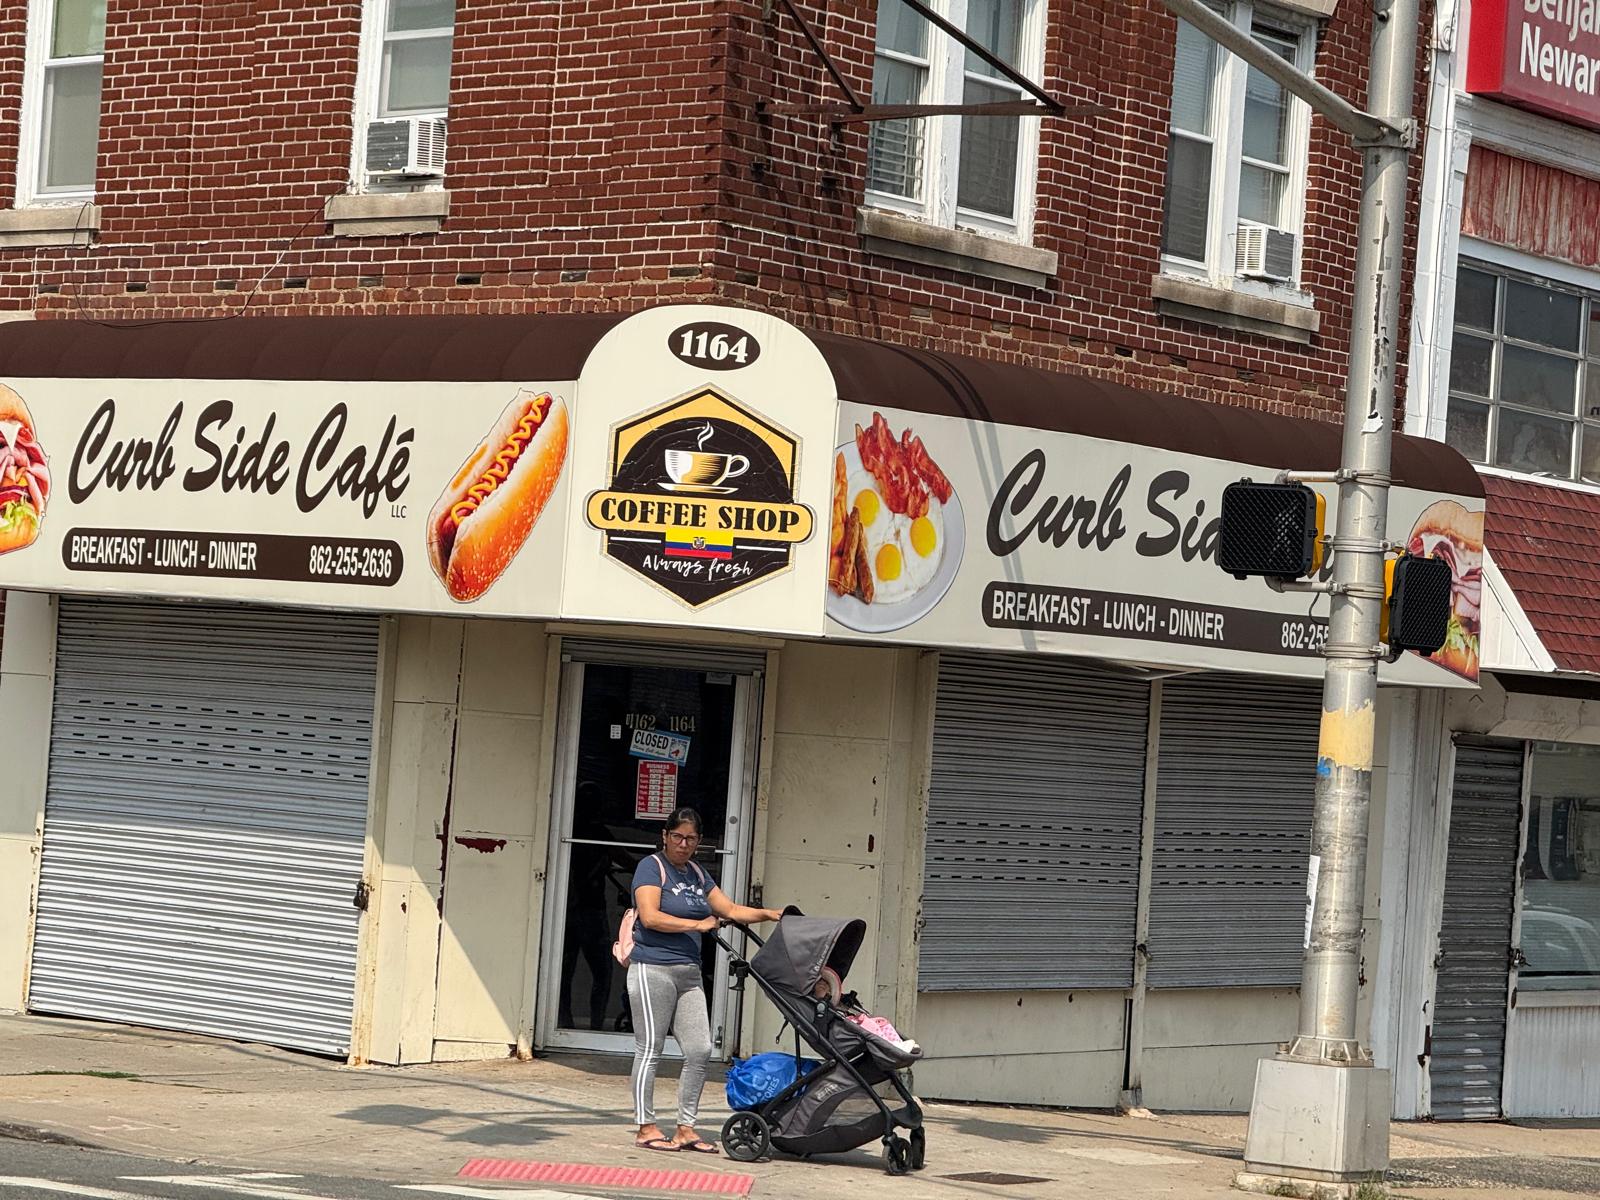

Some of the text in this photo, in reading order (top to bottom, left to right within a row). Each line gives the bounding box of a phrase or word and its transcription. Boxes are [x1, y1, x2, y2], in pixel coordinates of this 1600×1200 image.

[680, 330, 748, 363] 1164
[69, 399, 414, 519] Curb Side Café
[391, 505, 407, 518] LLC
[600, 498, 799, 534] COFFEE SHOP
[987, 449, 1131, 557] Curb
[71, 536, 146, 566] BREAKFAST
[155, 539, 198, 568] LUNCH
[208, 541, 257, 571] DINNER
[309, 545, 392, 578] 862-255-2636
[643, 555, 753, 582] Always fresh
[993, 590, 1091, 626] BREAKFAST
[1103, 601, 1157, 632] LUNCH
[1169, 608, 1224, 641] DINNER
[634, 731, 669, 750] CLOSED
